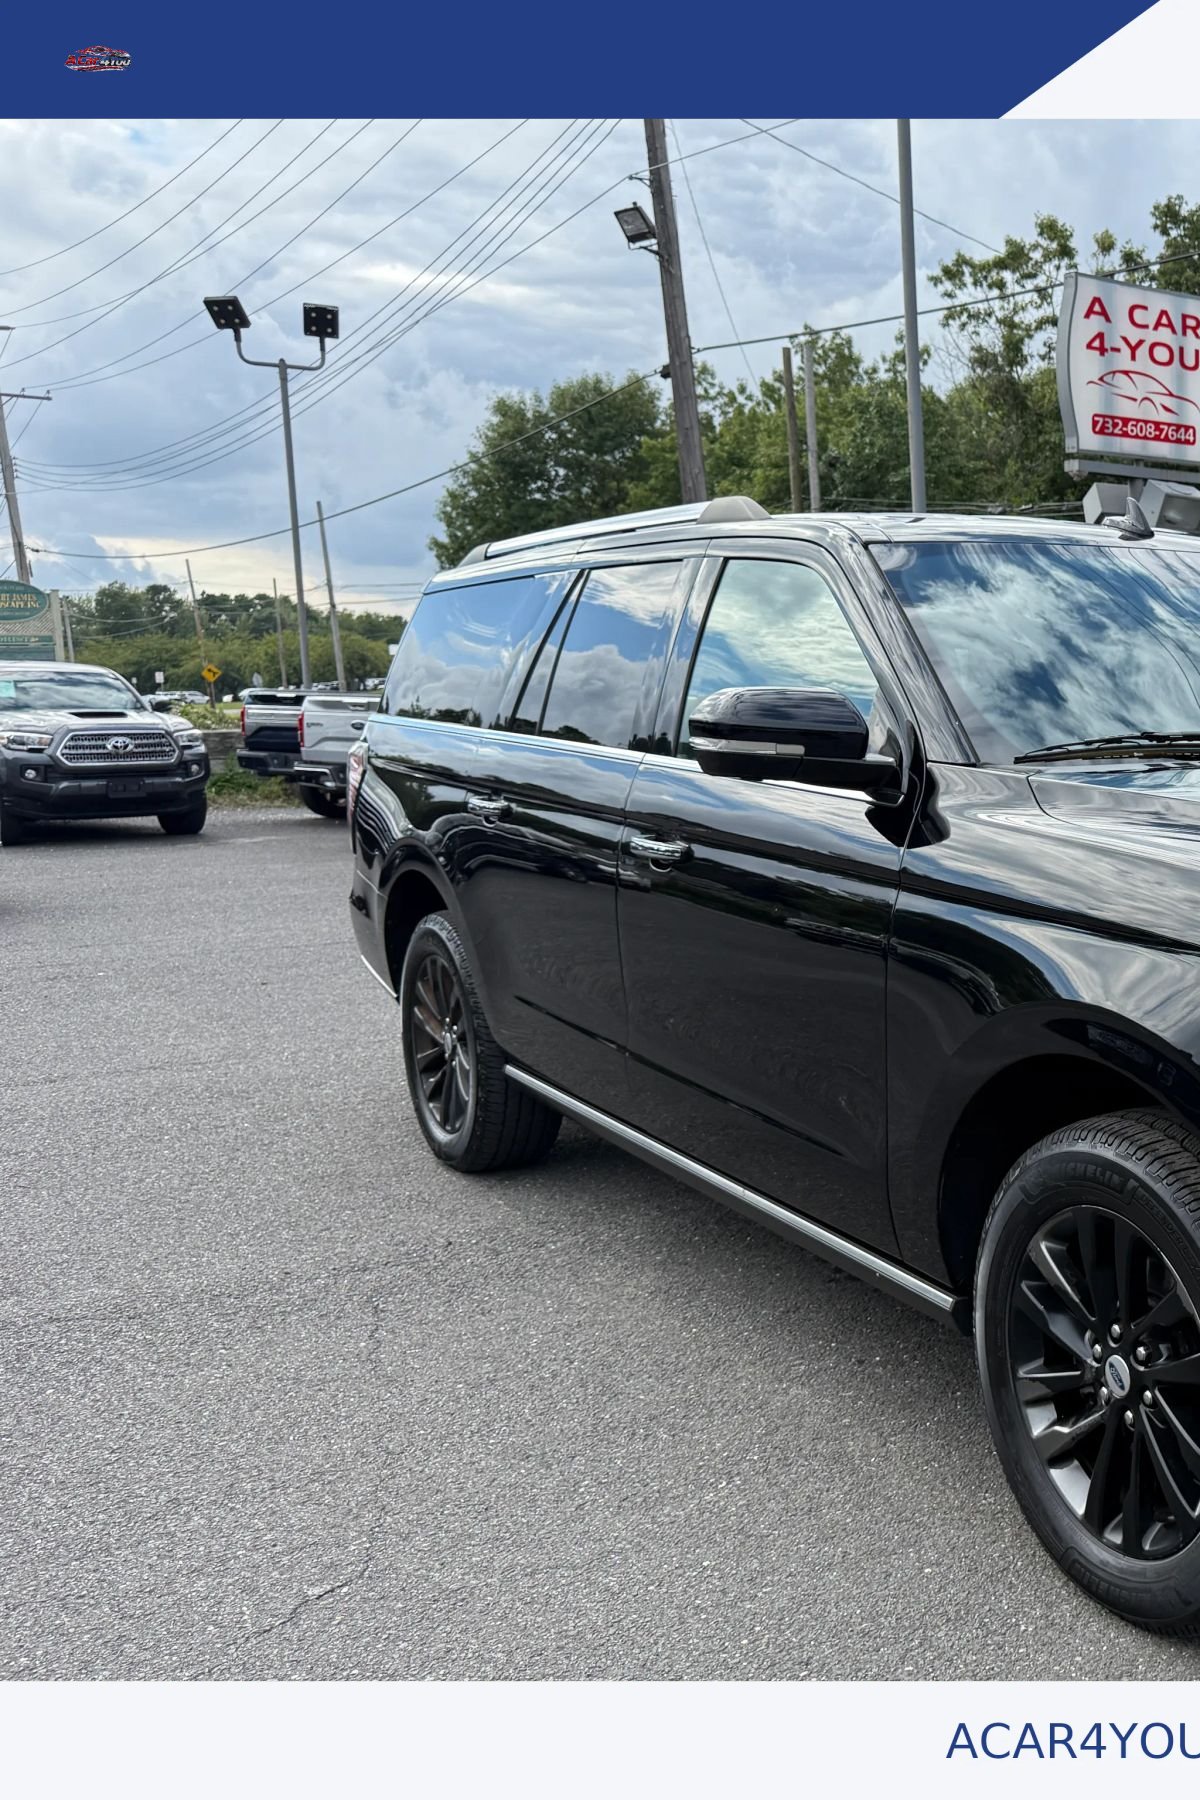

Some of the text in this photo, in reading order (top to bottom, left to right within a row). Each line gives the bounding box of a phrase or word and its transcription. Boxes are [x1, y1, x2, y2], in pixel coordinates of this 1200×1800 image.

[1083, 296, 1112, 324] A
[1085, 331, 1200, 372] 4-YOU
[1093, 416, 1195, 443] 732-608-7644
